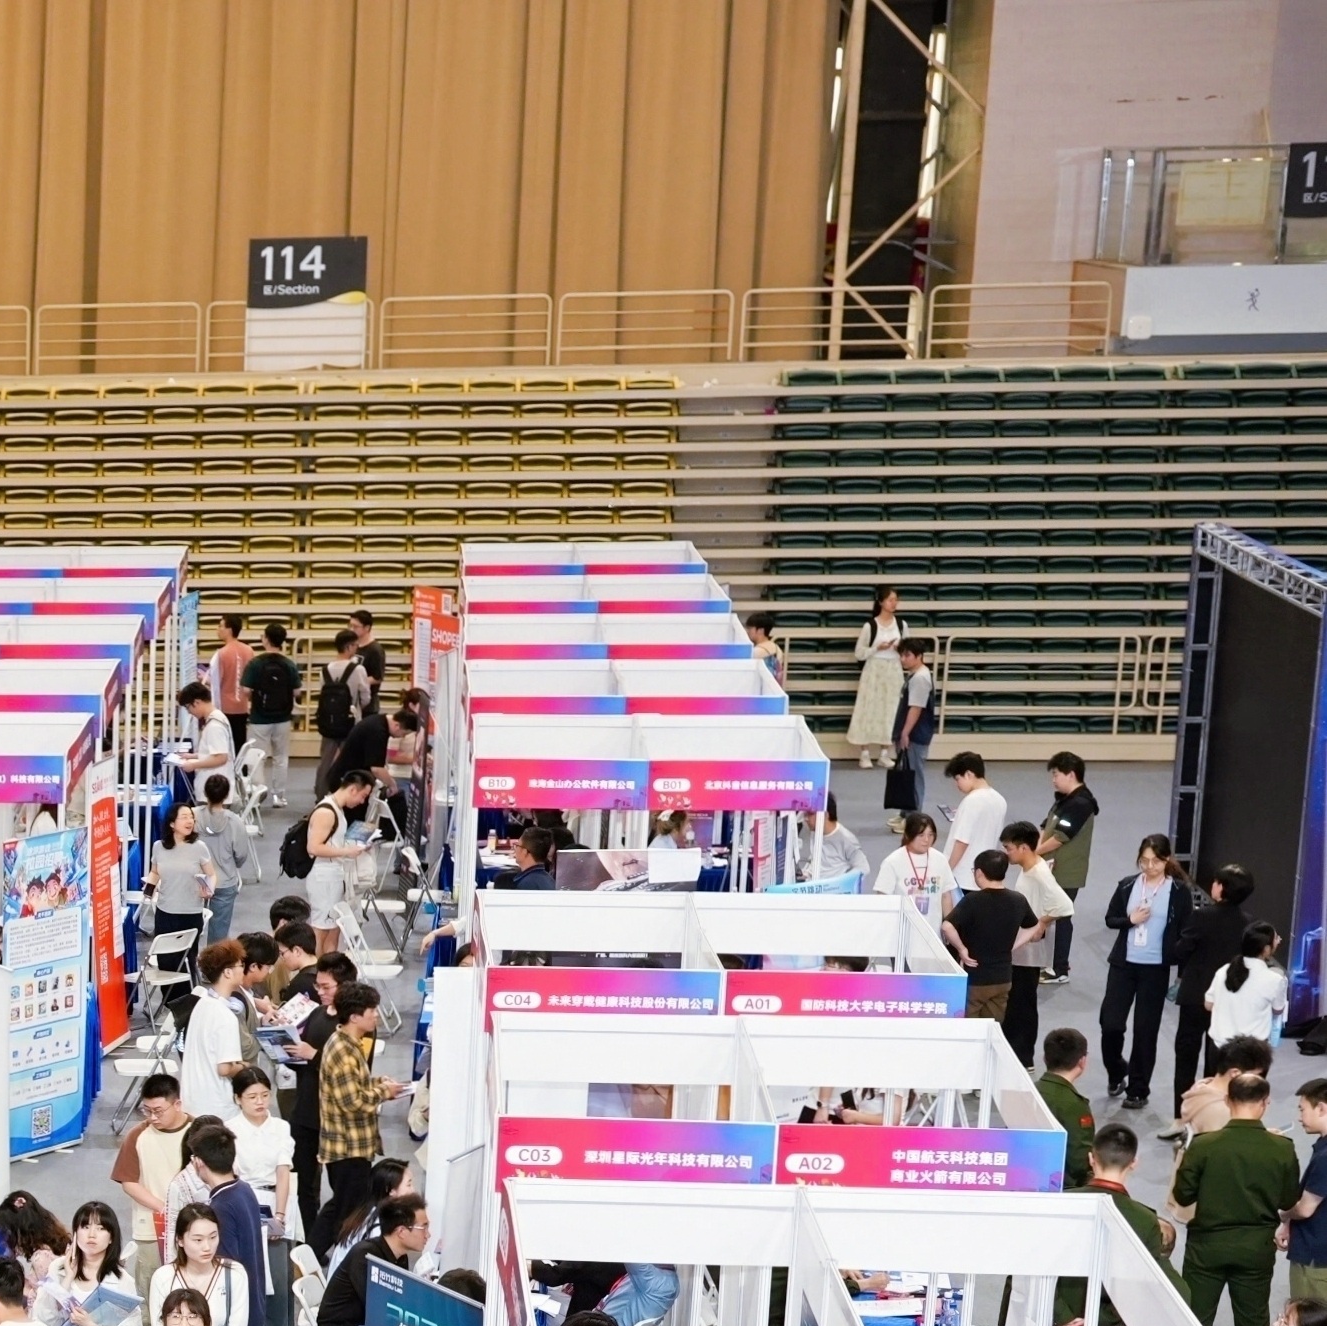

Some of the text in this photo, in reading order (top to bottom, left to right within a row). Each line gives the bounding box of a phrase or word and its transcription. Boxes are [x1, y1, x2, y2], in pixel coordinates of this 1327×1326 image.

[259, 246, 327, 280] 114
[487, 778, 508, 789] B10
[661, 779, 682, 790] B01
[503, 993, 714, 1010] C04 未来穿戴健康科技股份有限公司
[743, 997, 948, 1015] A01 国防科技大学电子科学学院
[518, 1149, 754, 1171] C03 深圳星际光年科技有限公司
[798, 1149, 1009, 1172] A02 中国航天科技集团
[889, 1169, 1007, 1187] 商业火箭有限公司
